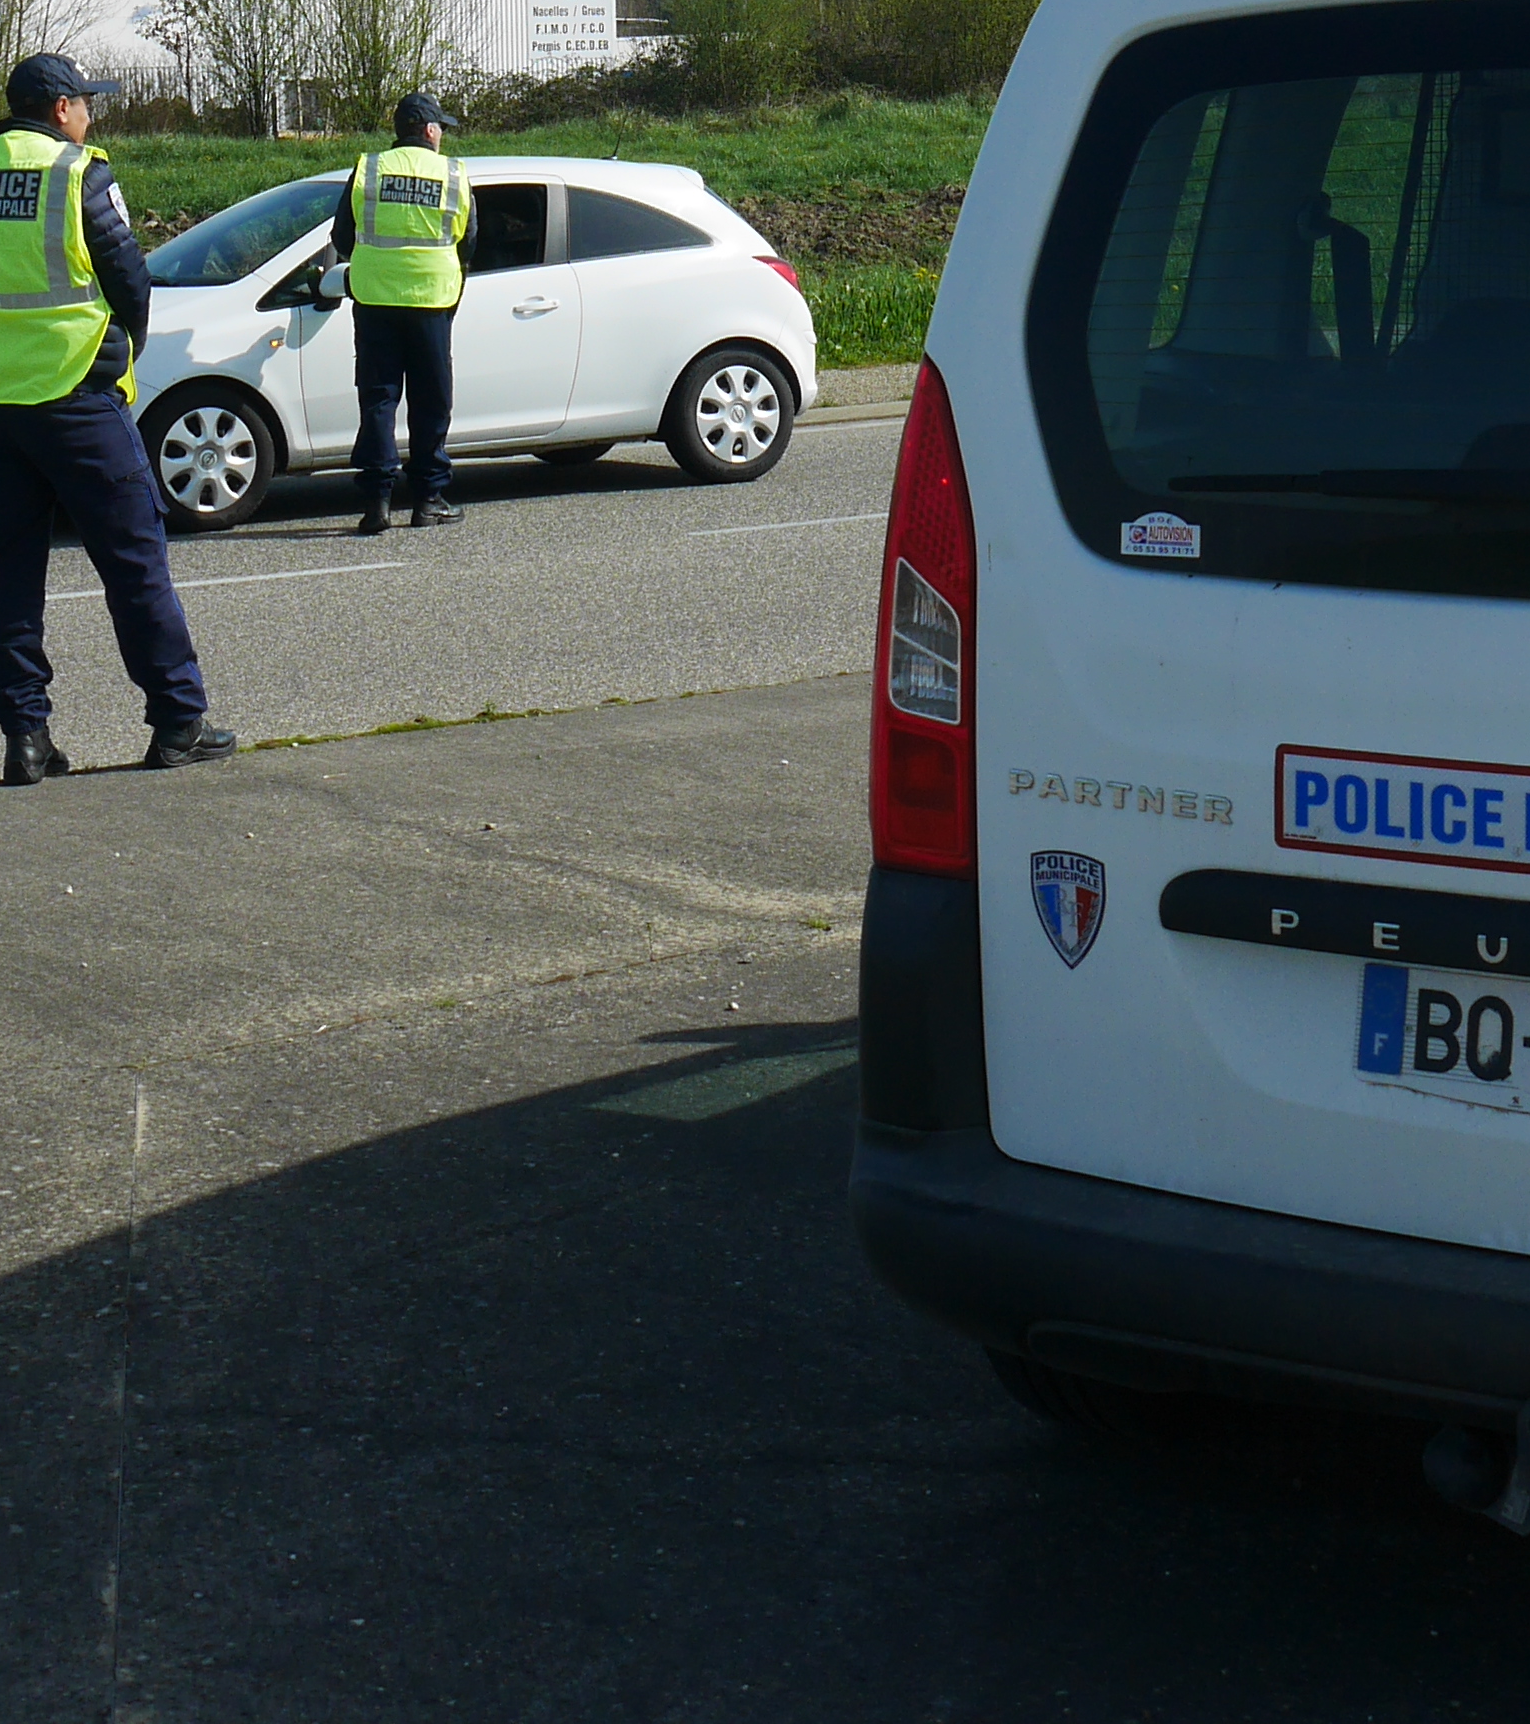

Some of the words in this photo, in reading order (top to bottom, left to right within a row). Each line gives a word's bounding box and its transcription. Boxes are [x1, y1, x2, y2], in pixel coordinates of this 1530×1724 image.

[532, 5, 569, 17] Nacelles
[582, 5, 606, 16] Grues
[581, 23, 604, 33] F.C.O
[532, 40, 561, 52] Permis
[382, 176, 441, 196] POLICE
[381, 190, 439, 206] MUNICIPALE
[1148, 525, 1194, 541] AUTOVISION
[1185, 547, 1195, 555] 71
[1009, 768, 1233, 825] PARTNER
[1295, 770, 1504, 849] POLICE
[1035, 855, 1100, 879] POLICE
[1035, 870, 1100, 889] MUNICIPALE
[1373, 1032, 1389, 1056] F
